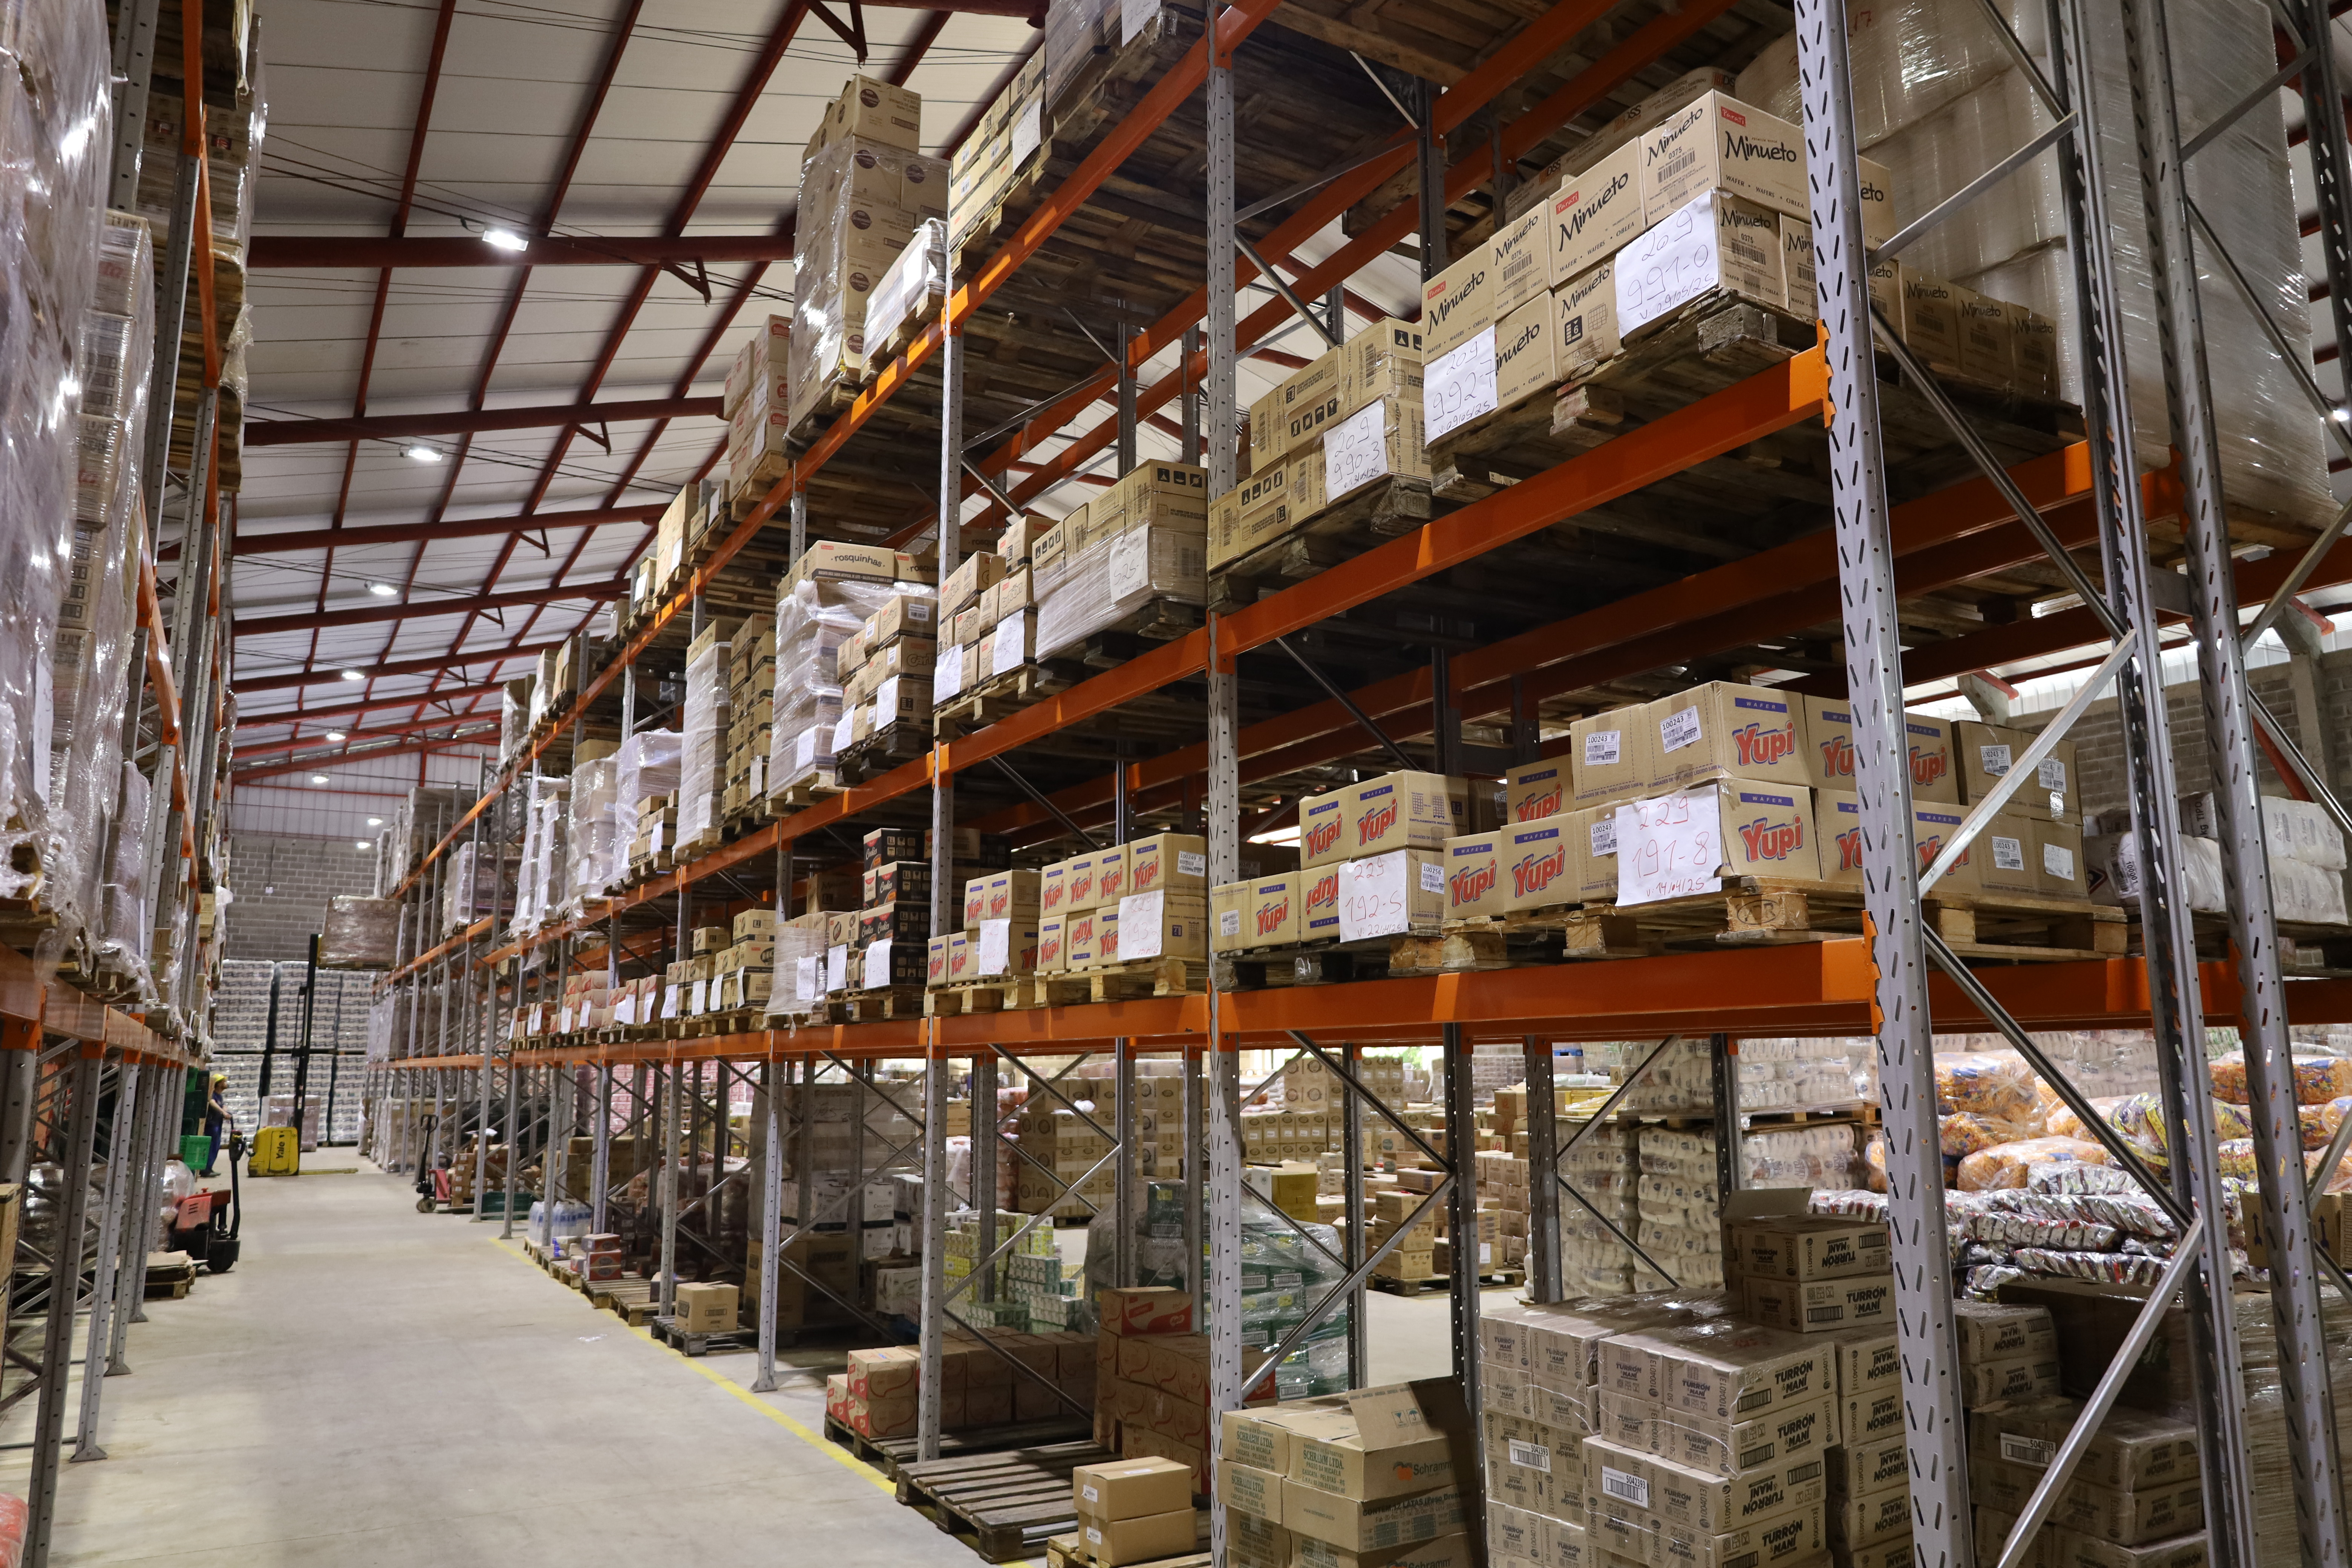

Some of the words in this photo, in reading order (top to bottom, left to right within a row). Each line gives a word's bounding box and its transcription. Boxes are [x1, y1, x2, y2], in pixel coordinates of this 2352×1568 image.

[1647, 108, 1703, 167] Minueto
[1724, 131, 1797, 162] Minueto
[1668, 147, 1682, 159] 0375
[1547, 160, 1561, 176] DSS
[1649, 204, 1664, 216] WAFER
[1670, 190, 1688, 204] WAFERS
[1694, 177, 1709, 190] OBLEA
[1726, 175, 1745, 187] WAFER
[1756, 187, 1775, 198] WAFERS
[1786, 198, 1804, 209] OBLEA
[1559, 173, 1628, 251] Minueto
[1721, 207, 1771, 228] Minueto
[1495, 215, 1538, 266] Minueto
[1642, 210, 1692, 261] 209
[1741, 233, 1753, 243] 0375
[1511, 249, 1522, 260] 0376
[1560, 258, 1577, 272] WAFER
[1587, 241, 1605, 255] WAFERS
[1616, 222, 1634, 237] OBLEA
[1496, 300, 1508, 310] WAFER
[1513, 289, 1527, 300] WAFERS
[1531, 278, 1543, 288] OBLEA
[1562, 269, 1609, 319] Minueto
[1765, 287, 1779, 296] OBLEA
[1907, 281, 1948, 300] Minueto
[1427, 271, 1484, 336] Minueto
[1962, 300, 2001, 317] Minueto
[1427, 343, 1441, 354] WAFER
[1449, 330, 1464, 341] WAFERS
[1473, 317, 1488, 328] OBLEA
[1573, 325, 1579, 334] 6
[1447, 341, 1478, 375] 209
[1433, 359, 1496, 421] 992-7
[1503, 386, 1519, 398] WAFERS
[1528, 371, 1545, 384] OBLEA
[1447, 401, 1490, 431] 09/05/25
[1334, 416, 1369, 457] 209
[1333, 441, 1380, 485] 990-3
[1351, 466, 1380, 485] 13/05/25
[835, 554, 882, 567] rosquinhas
[1662, 715, 1684, 730] 100243
[1732, 720, 1795, 766] Yupi
[1367, 788, 1386, 797] WAFER
[1652, 779, 1669, 787] UNIDADES
[1314, 804, 1332, 812] WAFER
[1516, 782, 1562, 822] Yupi
[1358, 797, 1398, 845] Yupi
[1638, 796, 1688, 830] 229
[1306, 812, 1342, 859] Yupi
[1593, 824, 1611, 834] 100243
[1738, 814, 1802, 862] Yupi
[866, 847, 877, 860] Cookies
[1633, 831, 1709, 878] 191-8
[1134, 854, 1159, 890] Yupi
[1355, 857, 1384, 880] 229
[1423, 866, 1441, 874] 100256
[1512, 842, 1565, 898] Yupi
[880, 880, 893, 893] Cookies
[1070, 871, 1093, 904] Yupi
[1100, 865, 1122, 899] Yupi
[1450, 858, 1496, 907] Yupi
[1656, 877, 1704, 896] 14/04/25
[990, 889, 1008, 917] Yupi
[1044, 879, 1064, 910] Yupi
[967, 894, 984, 922] Yupi
[1256, 895, 1288, 937] Yupi
[1346, 891, 1401, 922] 192-5
[862, 925, 873, 938] Cookies
[877, 922, 890, 934] Cookies
[1072, 917, 1093, 950] Yupi
[1368, 924, 1403, 936] 22/04/25
[1041, 934, 1060, 964] Yupi
[929, 952, 943, 979] Yupi
[951, 948, 966, 976] Yupi
[276, 1141, 285, 1159] Yale
[1827, 1242, 1847, 1253] MANÍ
[1822, 1250, 1856, 1268] TURRÓN
[1847, 1286, 1886, 1304] TURRÓN
[1858, 1298, 1880, 1313] MANÍ
[1494, 1337, 1514, 1345] TURRÓN
[1545, 1348, 1568, 1358] TURRÓN
[1616, 1363, 1641, 1373] TURRÓN
[1622, 1370, 1637, 1378] MANÍ
[1775, 1360, 1813, 1384] TURRÓN
[1682, 1380, 1710, 1392] TURRÓN
[1786, 1374, 1807, 1393] MANÍ
[1668, 1393, 1673, 1402] 50
[1778, 1413, 1815, 1439] TURRÓN
[1867, 1412, 1902, 1432] TURRÓN
[1237, 1431, 1259, 1444] SCHRAMM
[1260, 1437, 1274, 1448] LTDA.
[1788, 1427, 1809, 1447] MANÍ
[2030, 1439, 2053, 1451] 5042393
[1253, 1453, 1267, 1462] PELOTAS
[1256, 1446, 1271, 1455] MICAELA
[1303, 1450, 1328, 1465] SCHRAMM
[1329, 1456, 1344, 1469] LTDA.
[1531, 1444, 1548, 1456] 5042393
[1303, 1469, 1317, 1478] CASCATA
[1320, 1474, 1336, 1483] PELOTAS
[1325, 1467, 1341, 1476] MICAELA
[1413, 1461, 1452, 1476] Schramm
[1588, 1479, 1593, 1488] 50
[1626, 1475, 1645, 1488] 5042393
[1749, 1480, 1773, 1496] MANÍ
[1403, 1499, 1423, 1508] LATAS
[1663, 1489, 1691, 1502] TURRÓN
[1742, 1490, 1784, 1516] TURRÓN
[1502, 1525, 1524, 1535] TURRÓN
[1762, 1520, 1803, 1546] TURRÓN
[1773, 1537, 1796, 1554] MANÍ
